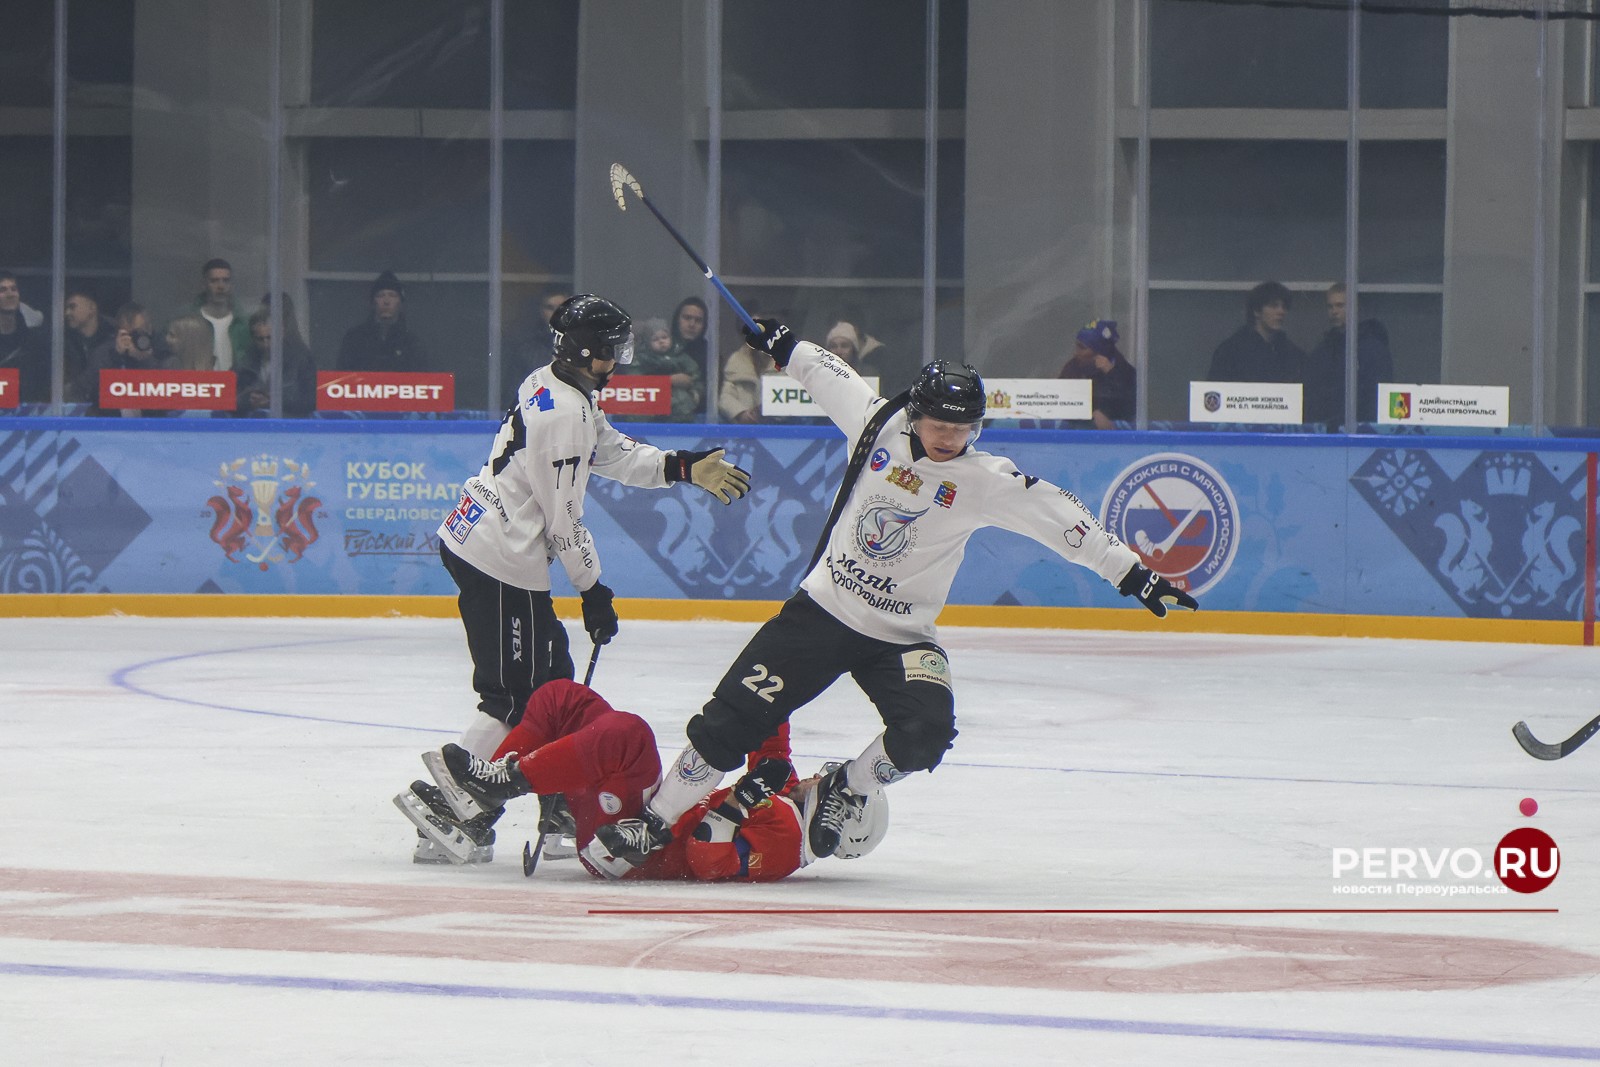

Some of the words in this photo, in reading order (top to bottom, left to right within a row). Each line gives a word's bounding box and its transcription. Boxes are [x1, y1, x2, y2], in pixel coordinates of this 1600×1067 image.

[109, 382, 225, 397] OLIMPBET
[327, 384, 443, 399] OLIMPBET
[600, 388, 660, 402] PBET
[772, 389, 816, 404] ХРО
[942, 404, 966, 412] CCM
[1419, 399, 1478, 407] АДМИНИСТРАЦИЯ
[1447, 408, 1497, 416] ПЕРВОУРАЛЬСК
[347, 462, 427, 480] КУБОК
[552, 456, 581, 489] 77
[1126, 463, 1178, 490] ХОККЕЯ
[1181, 465, 1191, 476] С
[347, 483, 463, 500] ГУБЕРНАТ
[1192, 471, 1228, 515] МЯЧОМ
[1205, 518, 1230, 575] РОССИИ
[511, 617, 522, 662] STEX
[741, 664, 785, 704] 22
